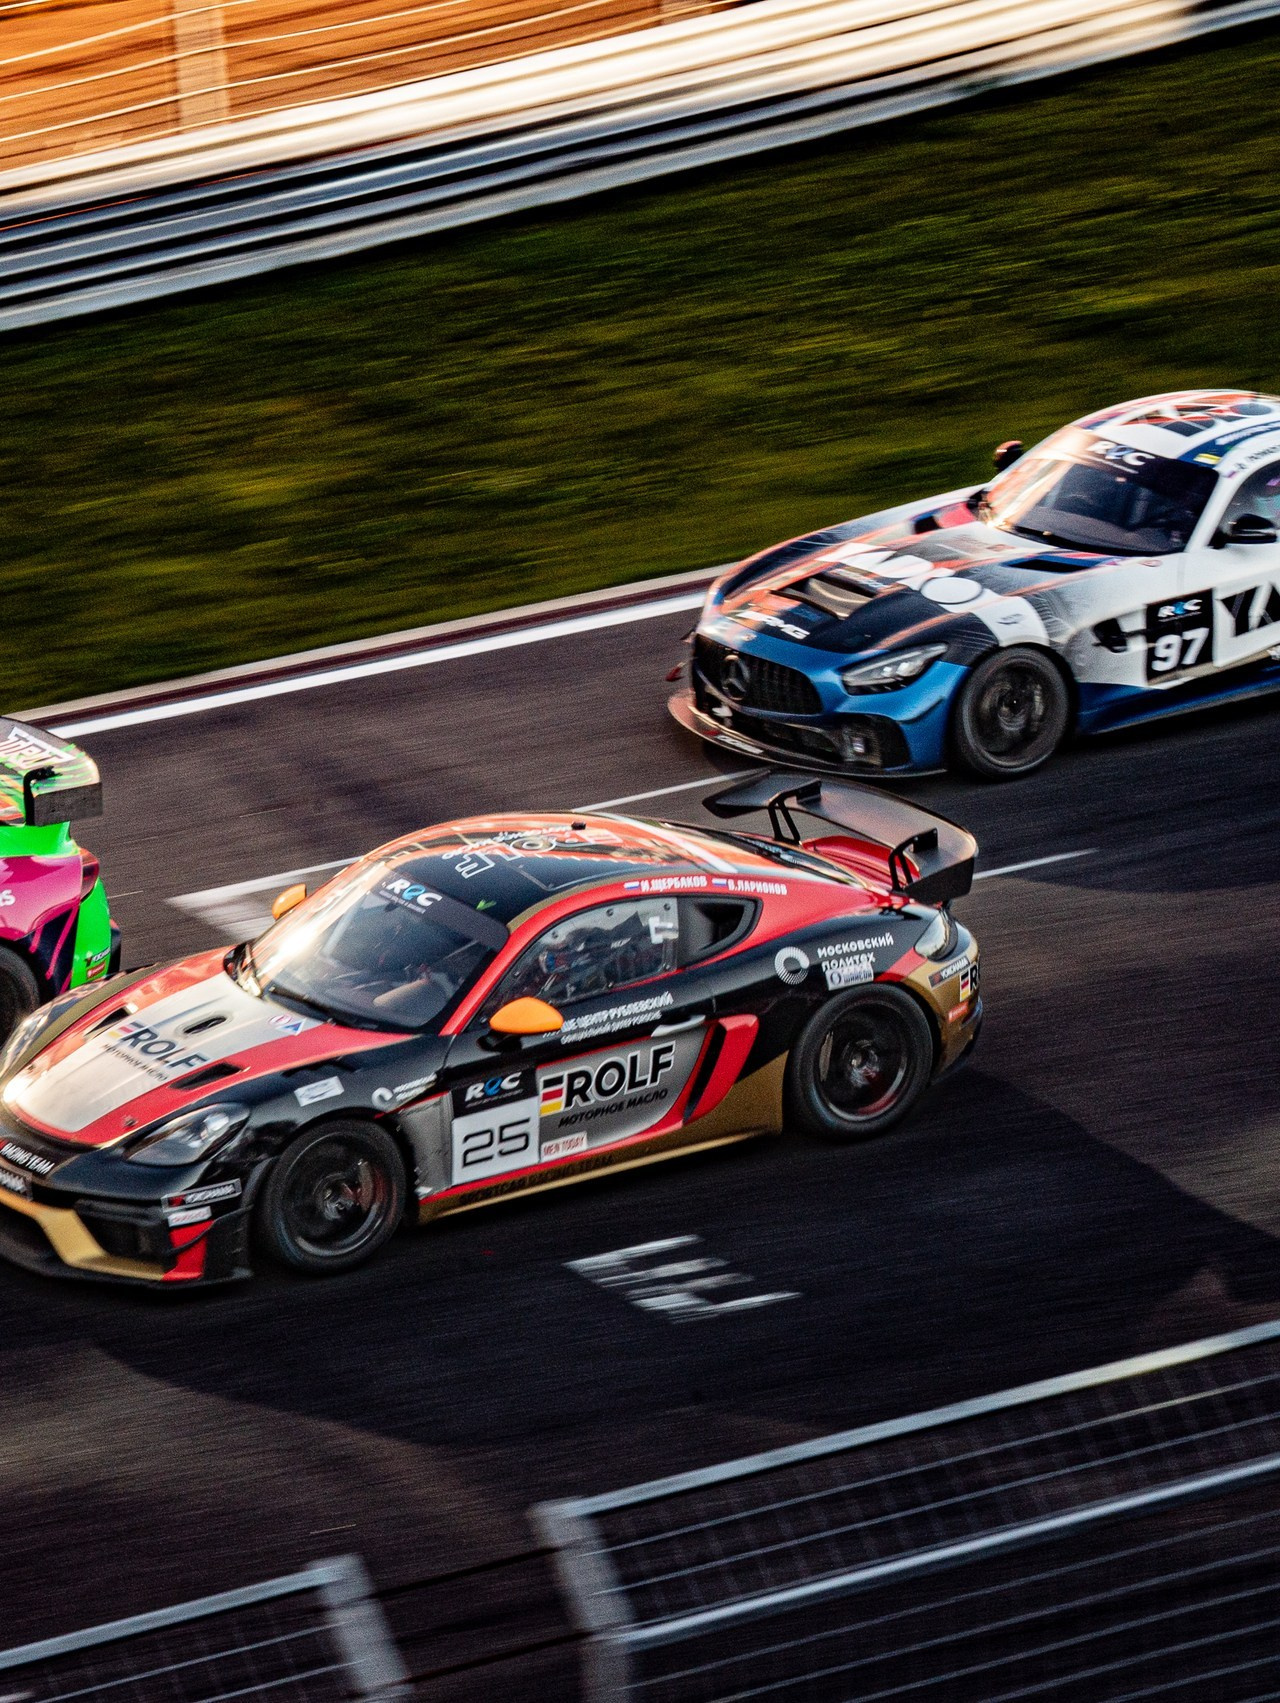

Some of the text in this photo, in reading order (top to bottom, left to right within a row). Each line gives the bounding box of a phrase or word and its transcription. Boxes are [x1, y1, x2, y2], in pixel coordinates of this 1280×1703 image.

[1151, 627, 1210, 672] 97
[640, 875, 708, 892] И.ЩЕРБАКОВ
[727, 879, 788, 895] В.ЛАРИОНОВ
[817, 932, 895, 959] МОСКОВСКИЙ
[118, 1028, 209, 1069] ROLF
[563, 1044, 676, 1110] ROLF
[557, 1088, 669, 1129] МОТОРНОЕ МАСЛО
[0, 1142, 56, 1176] RACING TEAM
[462, 1117, 532, 1169] 25
